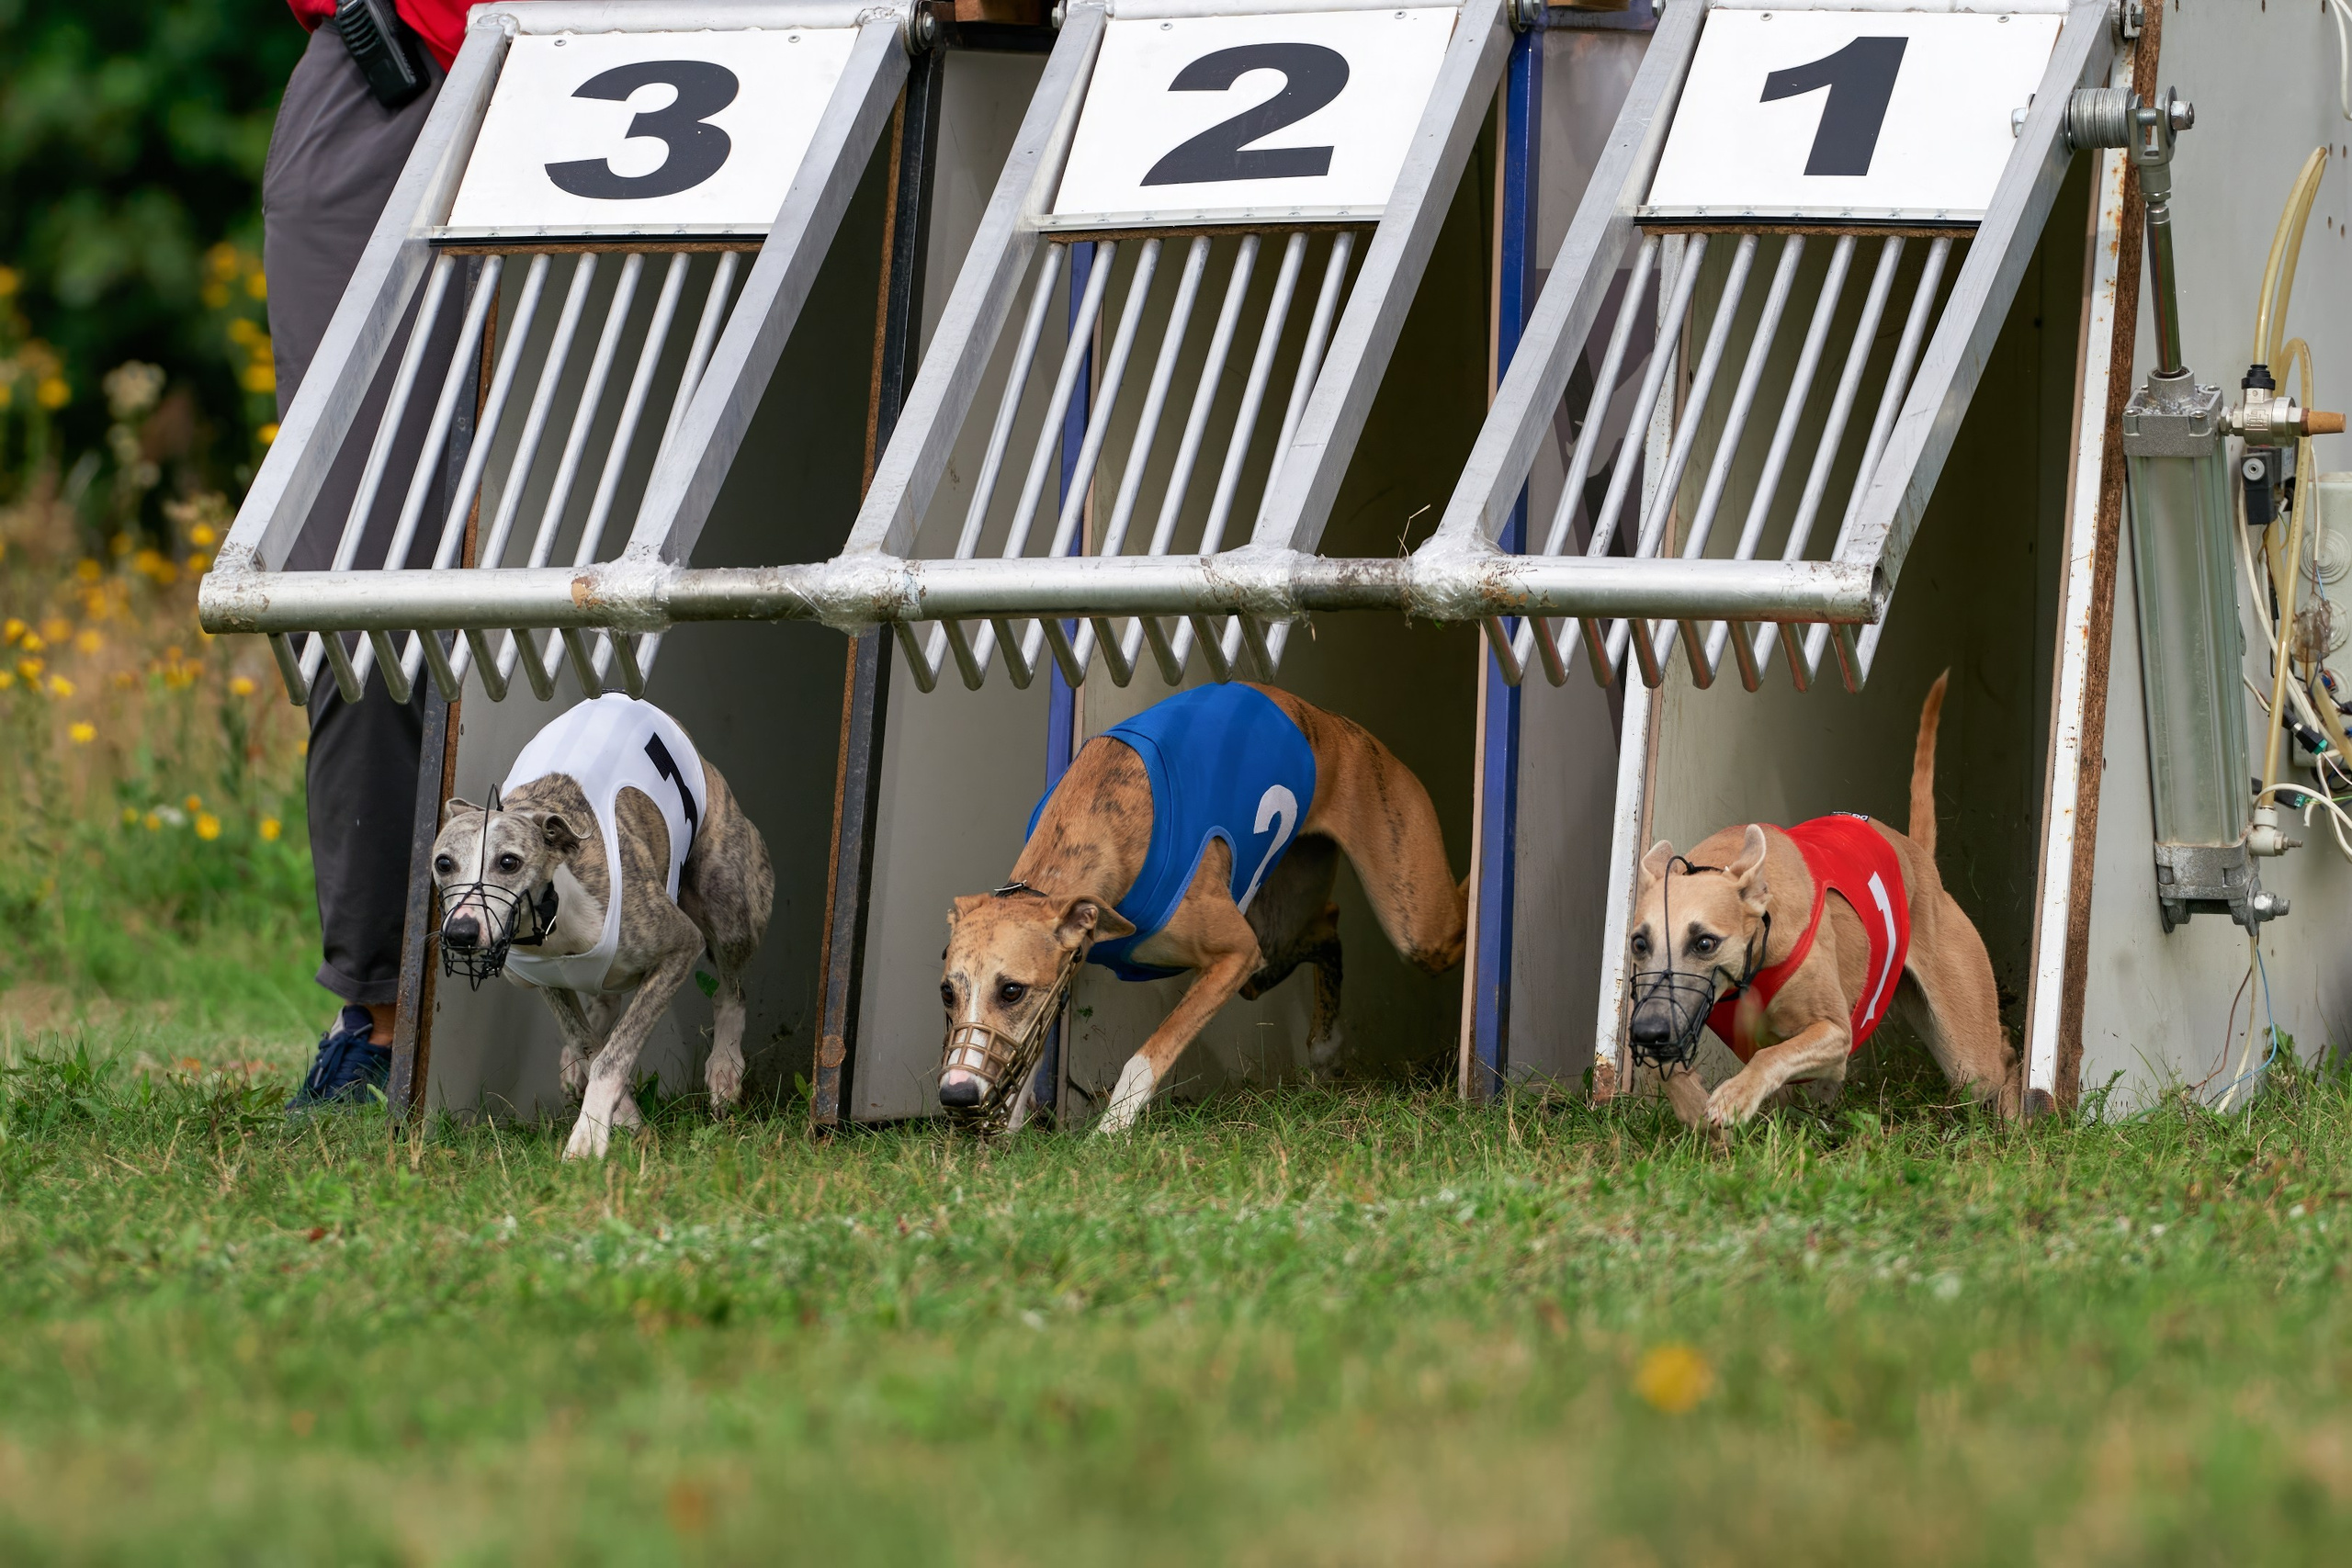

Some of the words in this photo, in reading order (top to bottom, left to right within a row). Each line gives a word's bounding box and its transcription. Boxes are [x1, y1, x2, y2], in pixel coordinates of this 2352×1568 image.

[545, 61, 739, 199] 3
[1140, 43, 1350, 186] 2
[1759, 37, 1908, 175] 1
[1238, 784, 1298, 916] 2
[1860, 871, 1895, 1029] 1
